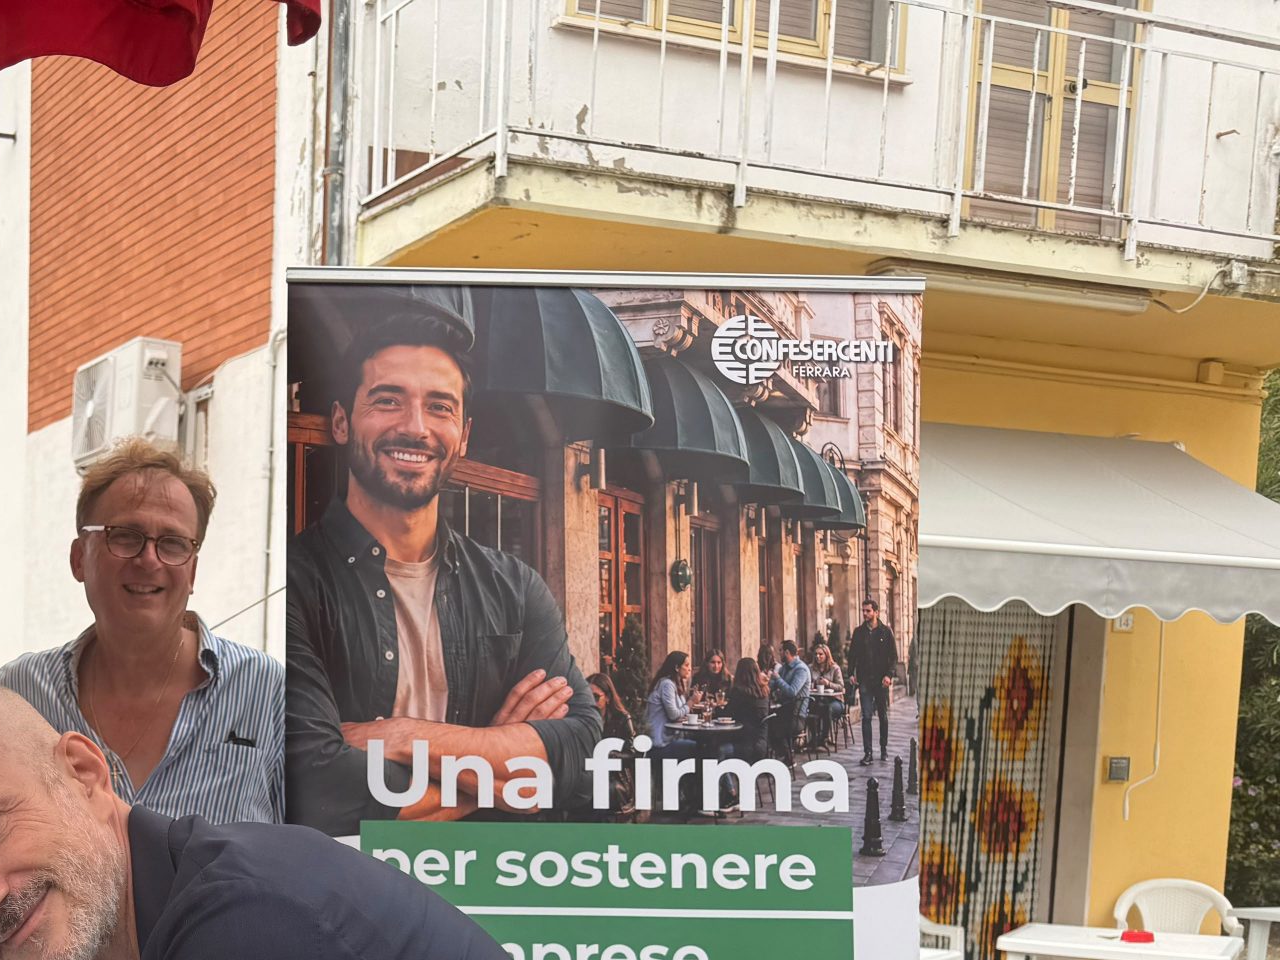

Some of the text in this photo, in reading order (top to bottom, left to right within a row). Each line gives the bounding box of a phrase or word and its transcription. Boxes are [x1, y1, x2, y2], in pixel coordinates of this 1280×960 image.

[734, 339, 894, 363] CONFESERCENTI
[792, 366, 850, 378] FERRARA
[365, 734, 850, 814] Una firma
[495, 844, 817, 890] sostenere
